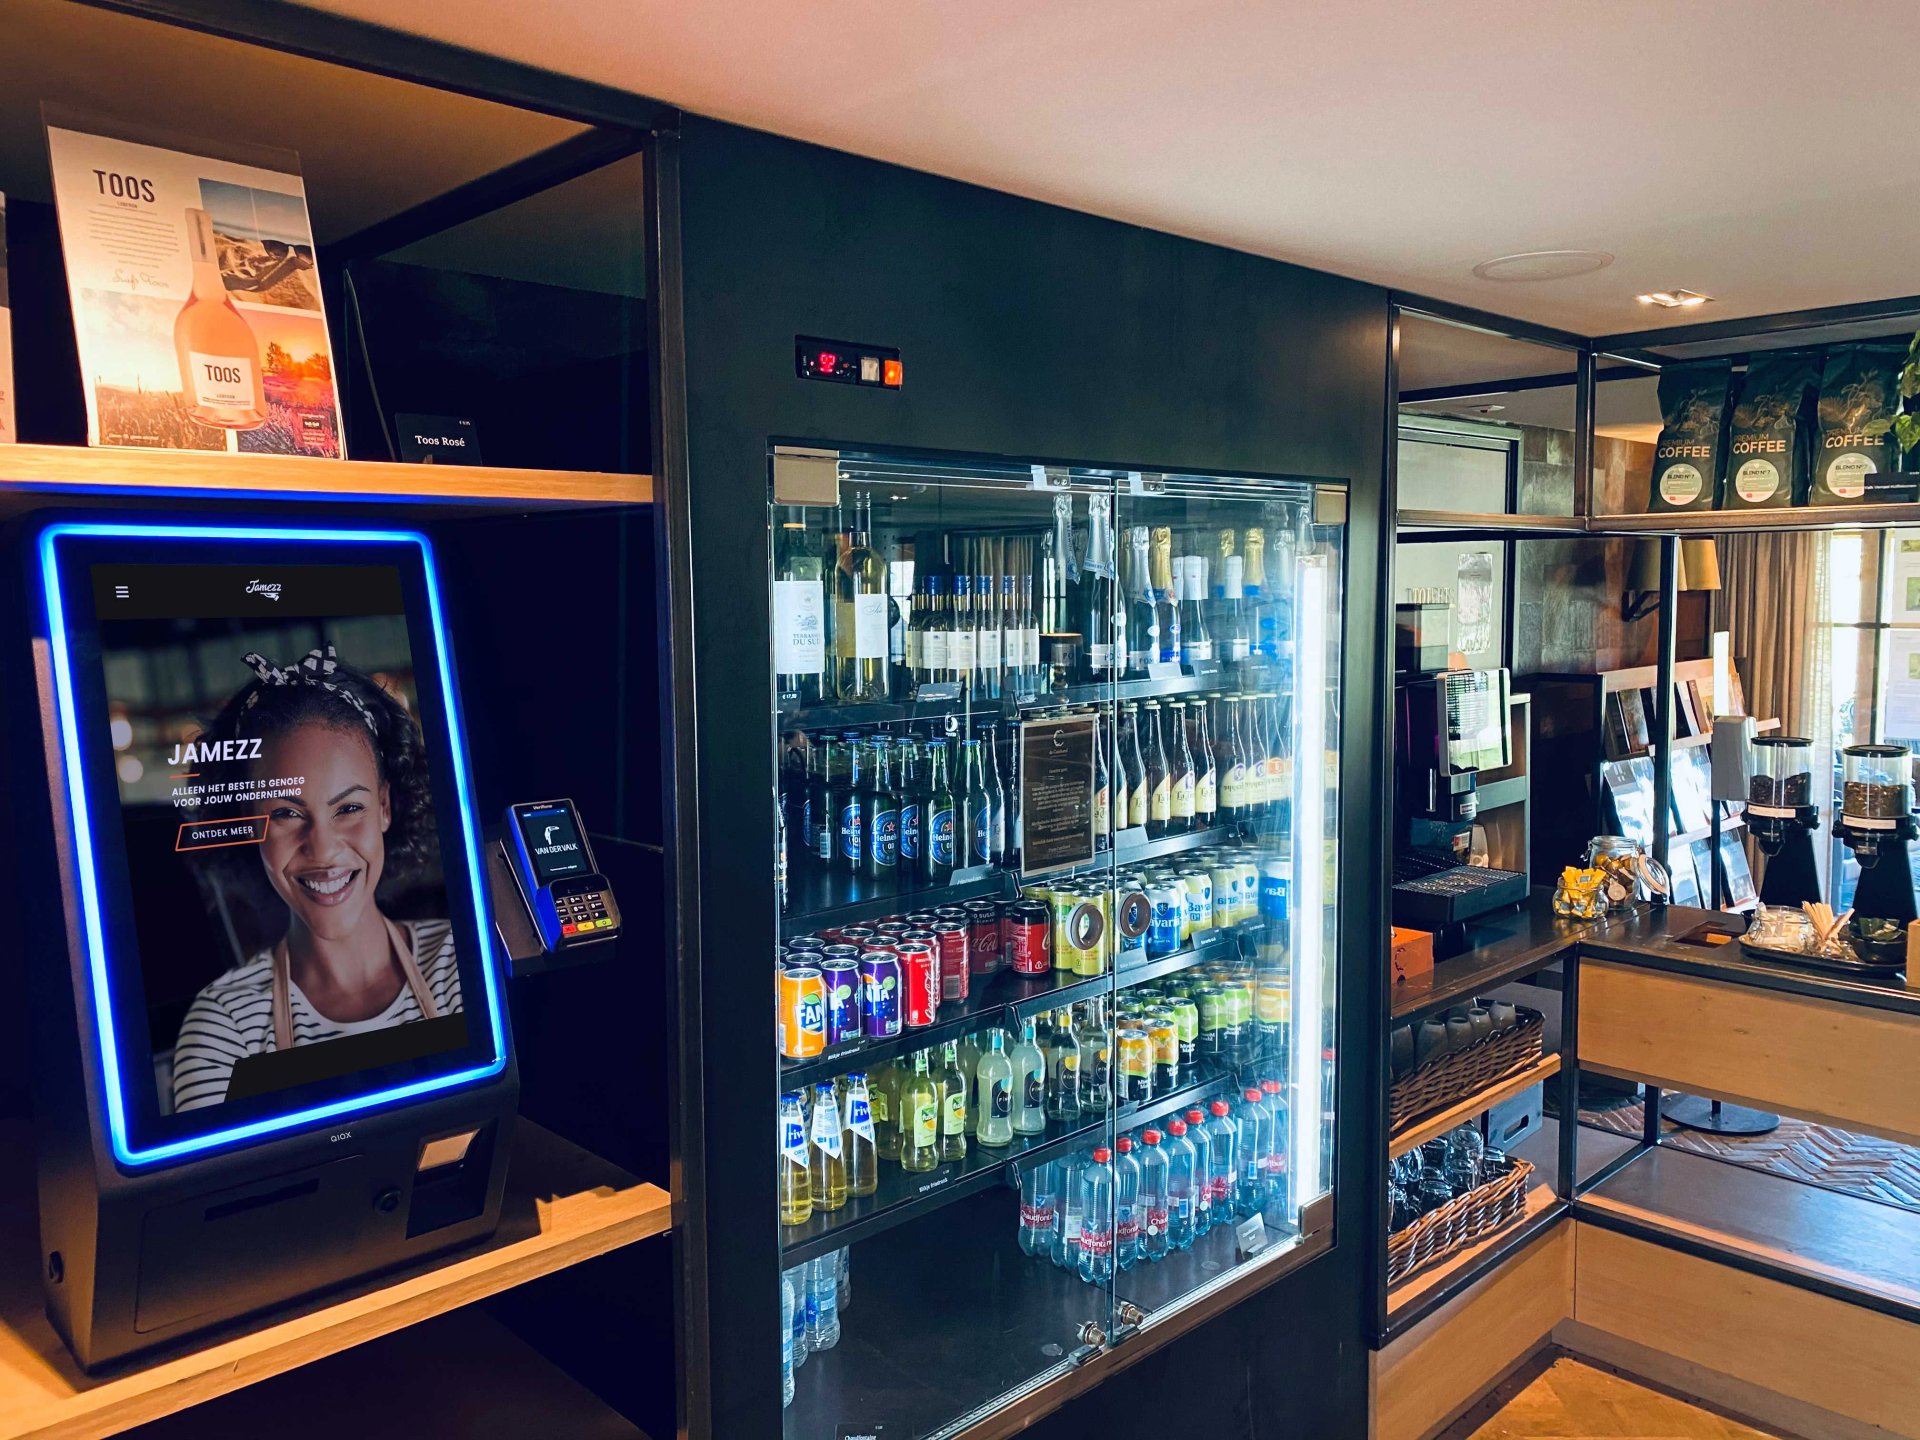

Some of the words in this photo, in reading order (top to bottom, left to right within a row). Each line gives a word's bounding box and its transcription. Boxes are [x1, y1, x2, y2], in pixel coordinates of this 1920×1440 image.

[92, 169, 155, 203] TOOS
[204, 364, 241, 384] TOOS
[414, 435, 439, 446] Toos
[441, 436, 465, 447] Rosé
[1732, 440, 1786, 455] COFFEE
[1824, 434, 1885, 449] COFFEE
[1658, 445, 1711, 459] COFFEE
[246, 579, 282, 594] Jamezz
[167, 738, 263, 766] JAMEZZ
[171, 785, 206, 797] ALLEEN
[208, 783, 225, 794] HET
[228, 780, 255, 792] BESTE
[257, 779, 266, 788] IS
[268, 776, 306, 788] GENOEG
[173, 796, 202, 808] VOOR
[204, 793, 233, 805] JOUW
[235, 787, 302, 802] ONDERNEMING
[191, 828, 228, 840] ONTDEK
[230, 825, 254, 836] MEER
[535, 846, 549, 855] VAN
[550, 845, 562, 853] DER
[562, 843, 578, 851] VALK
[331, 1132, 351, 1142] QIOX
